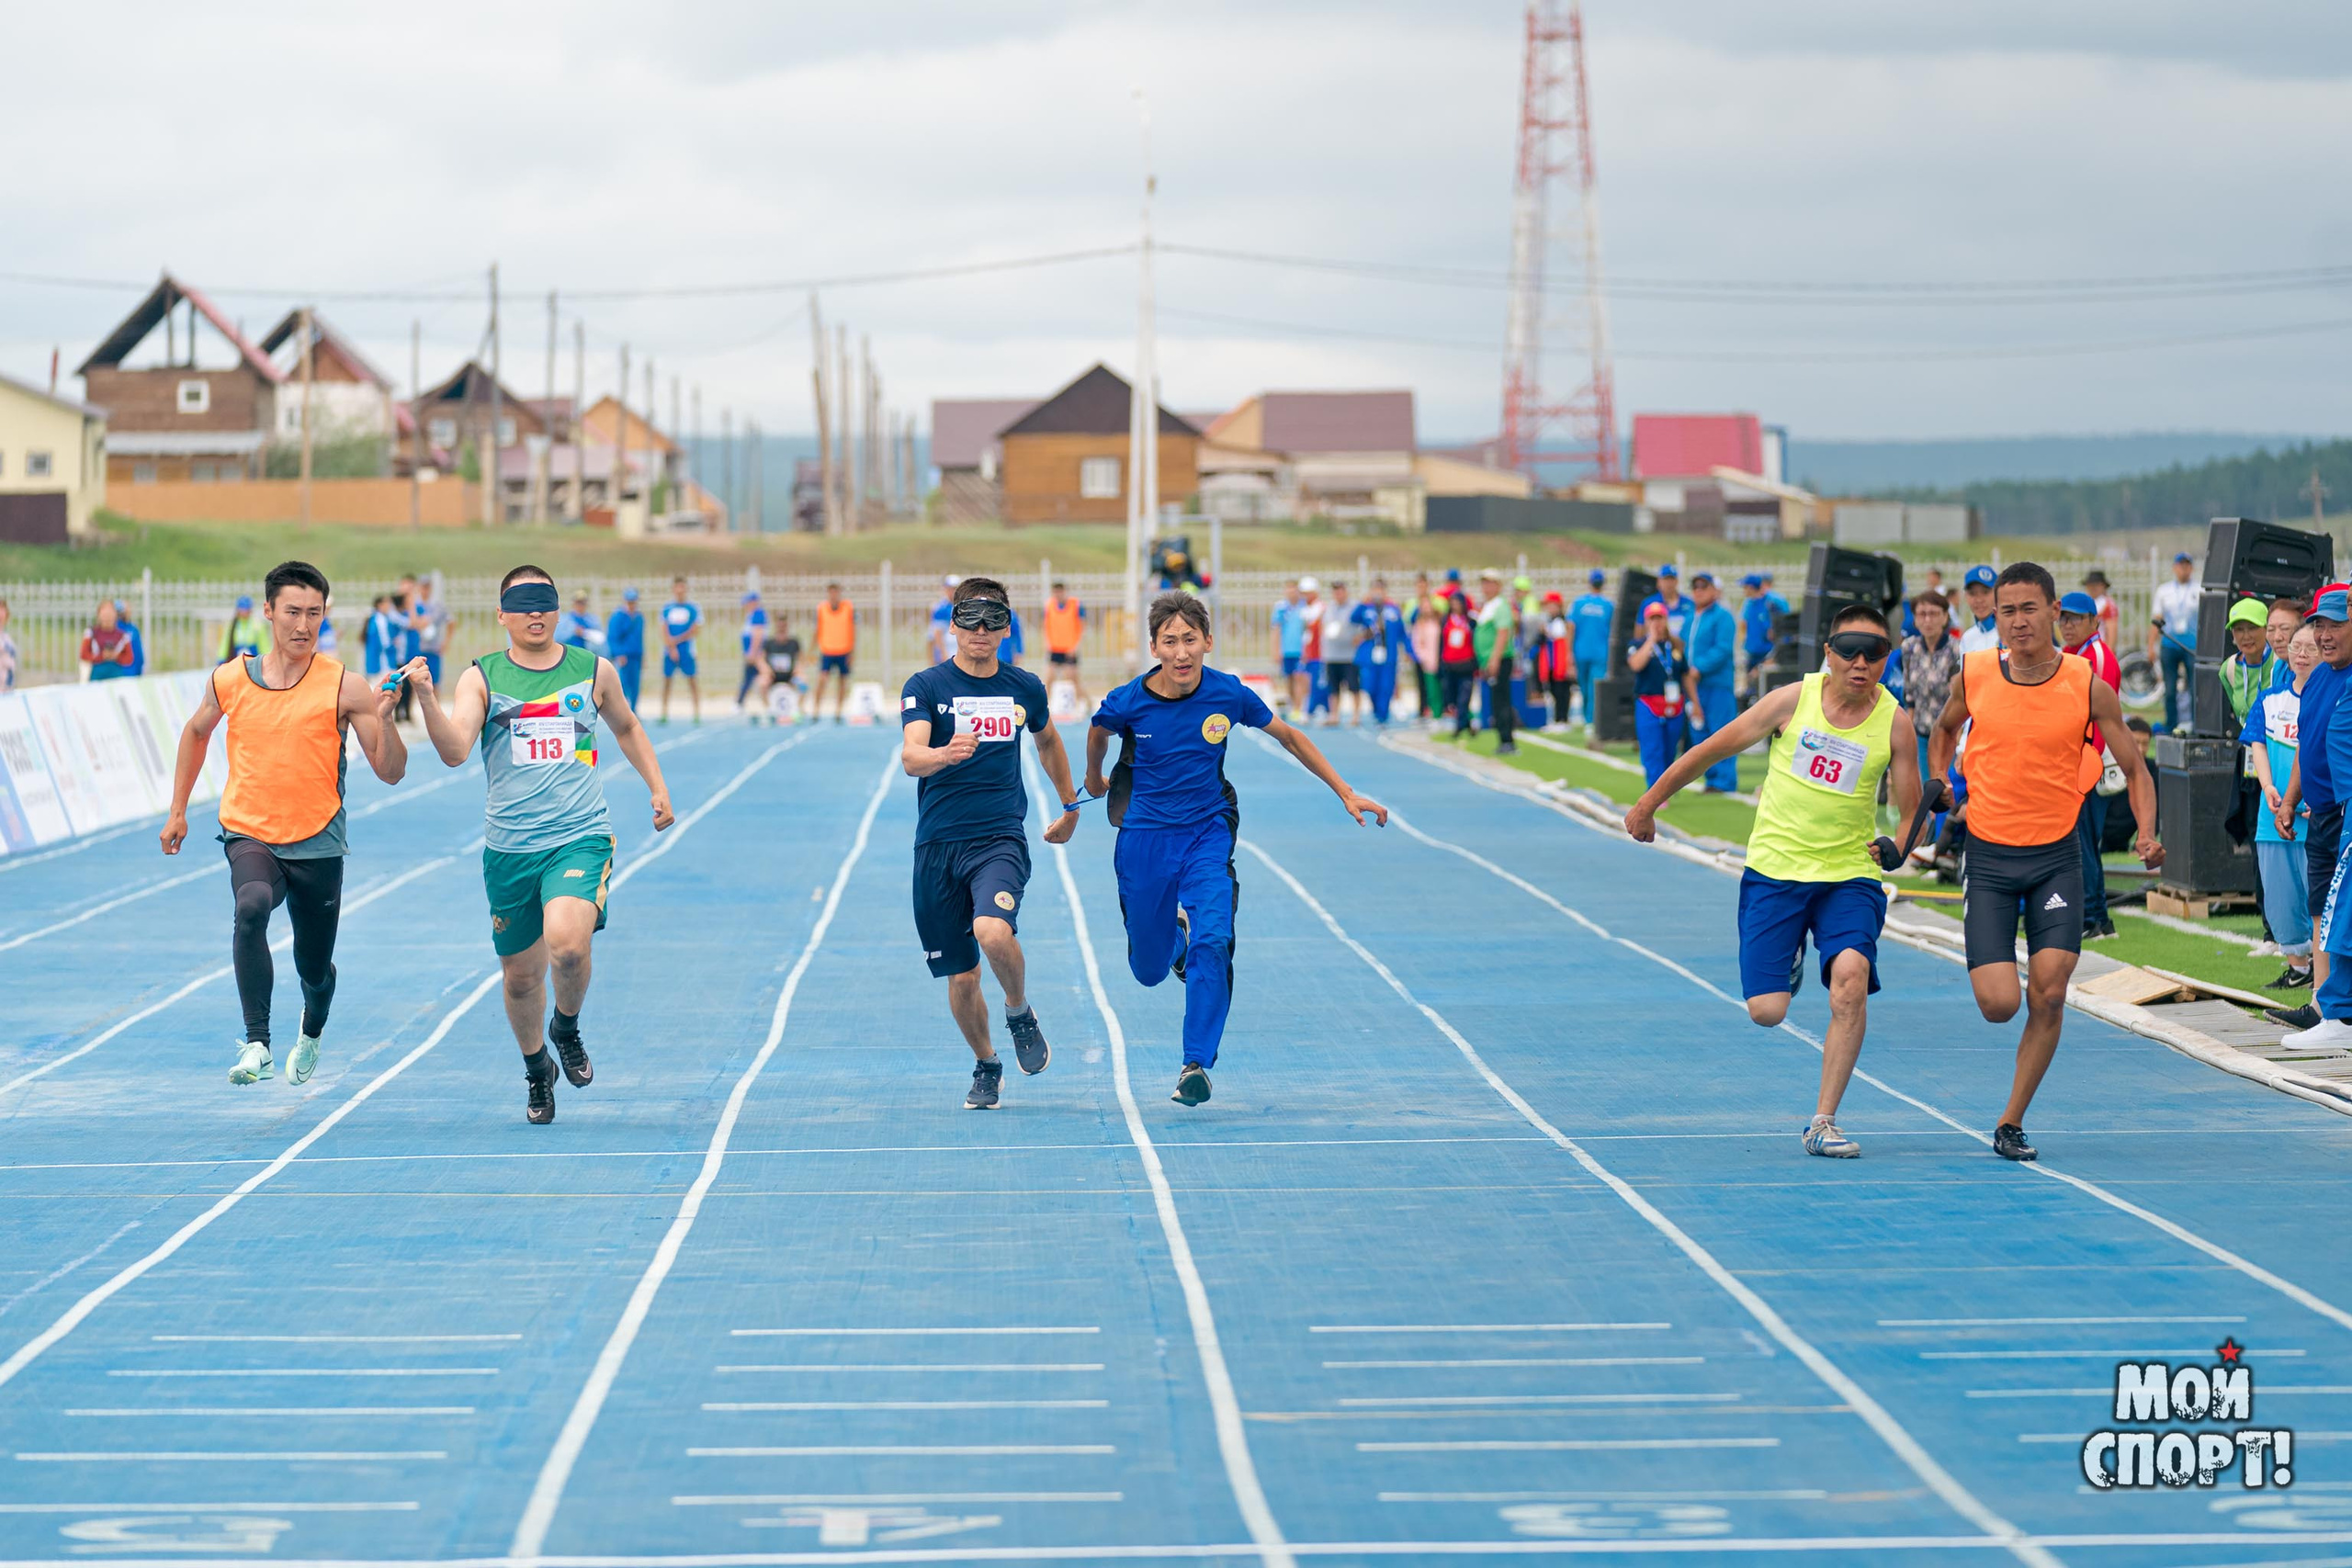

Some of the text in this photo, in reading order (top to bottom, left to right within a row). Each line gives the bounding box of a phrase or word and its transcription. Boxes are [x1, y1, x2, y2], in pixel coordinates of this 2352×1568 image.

[970, 716, 1012, 737] 290
[526, 738, 563, 760] 113
[1809, 754, 1843, 784] 63
[2044, 901, 2068, 910] adidas
